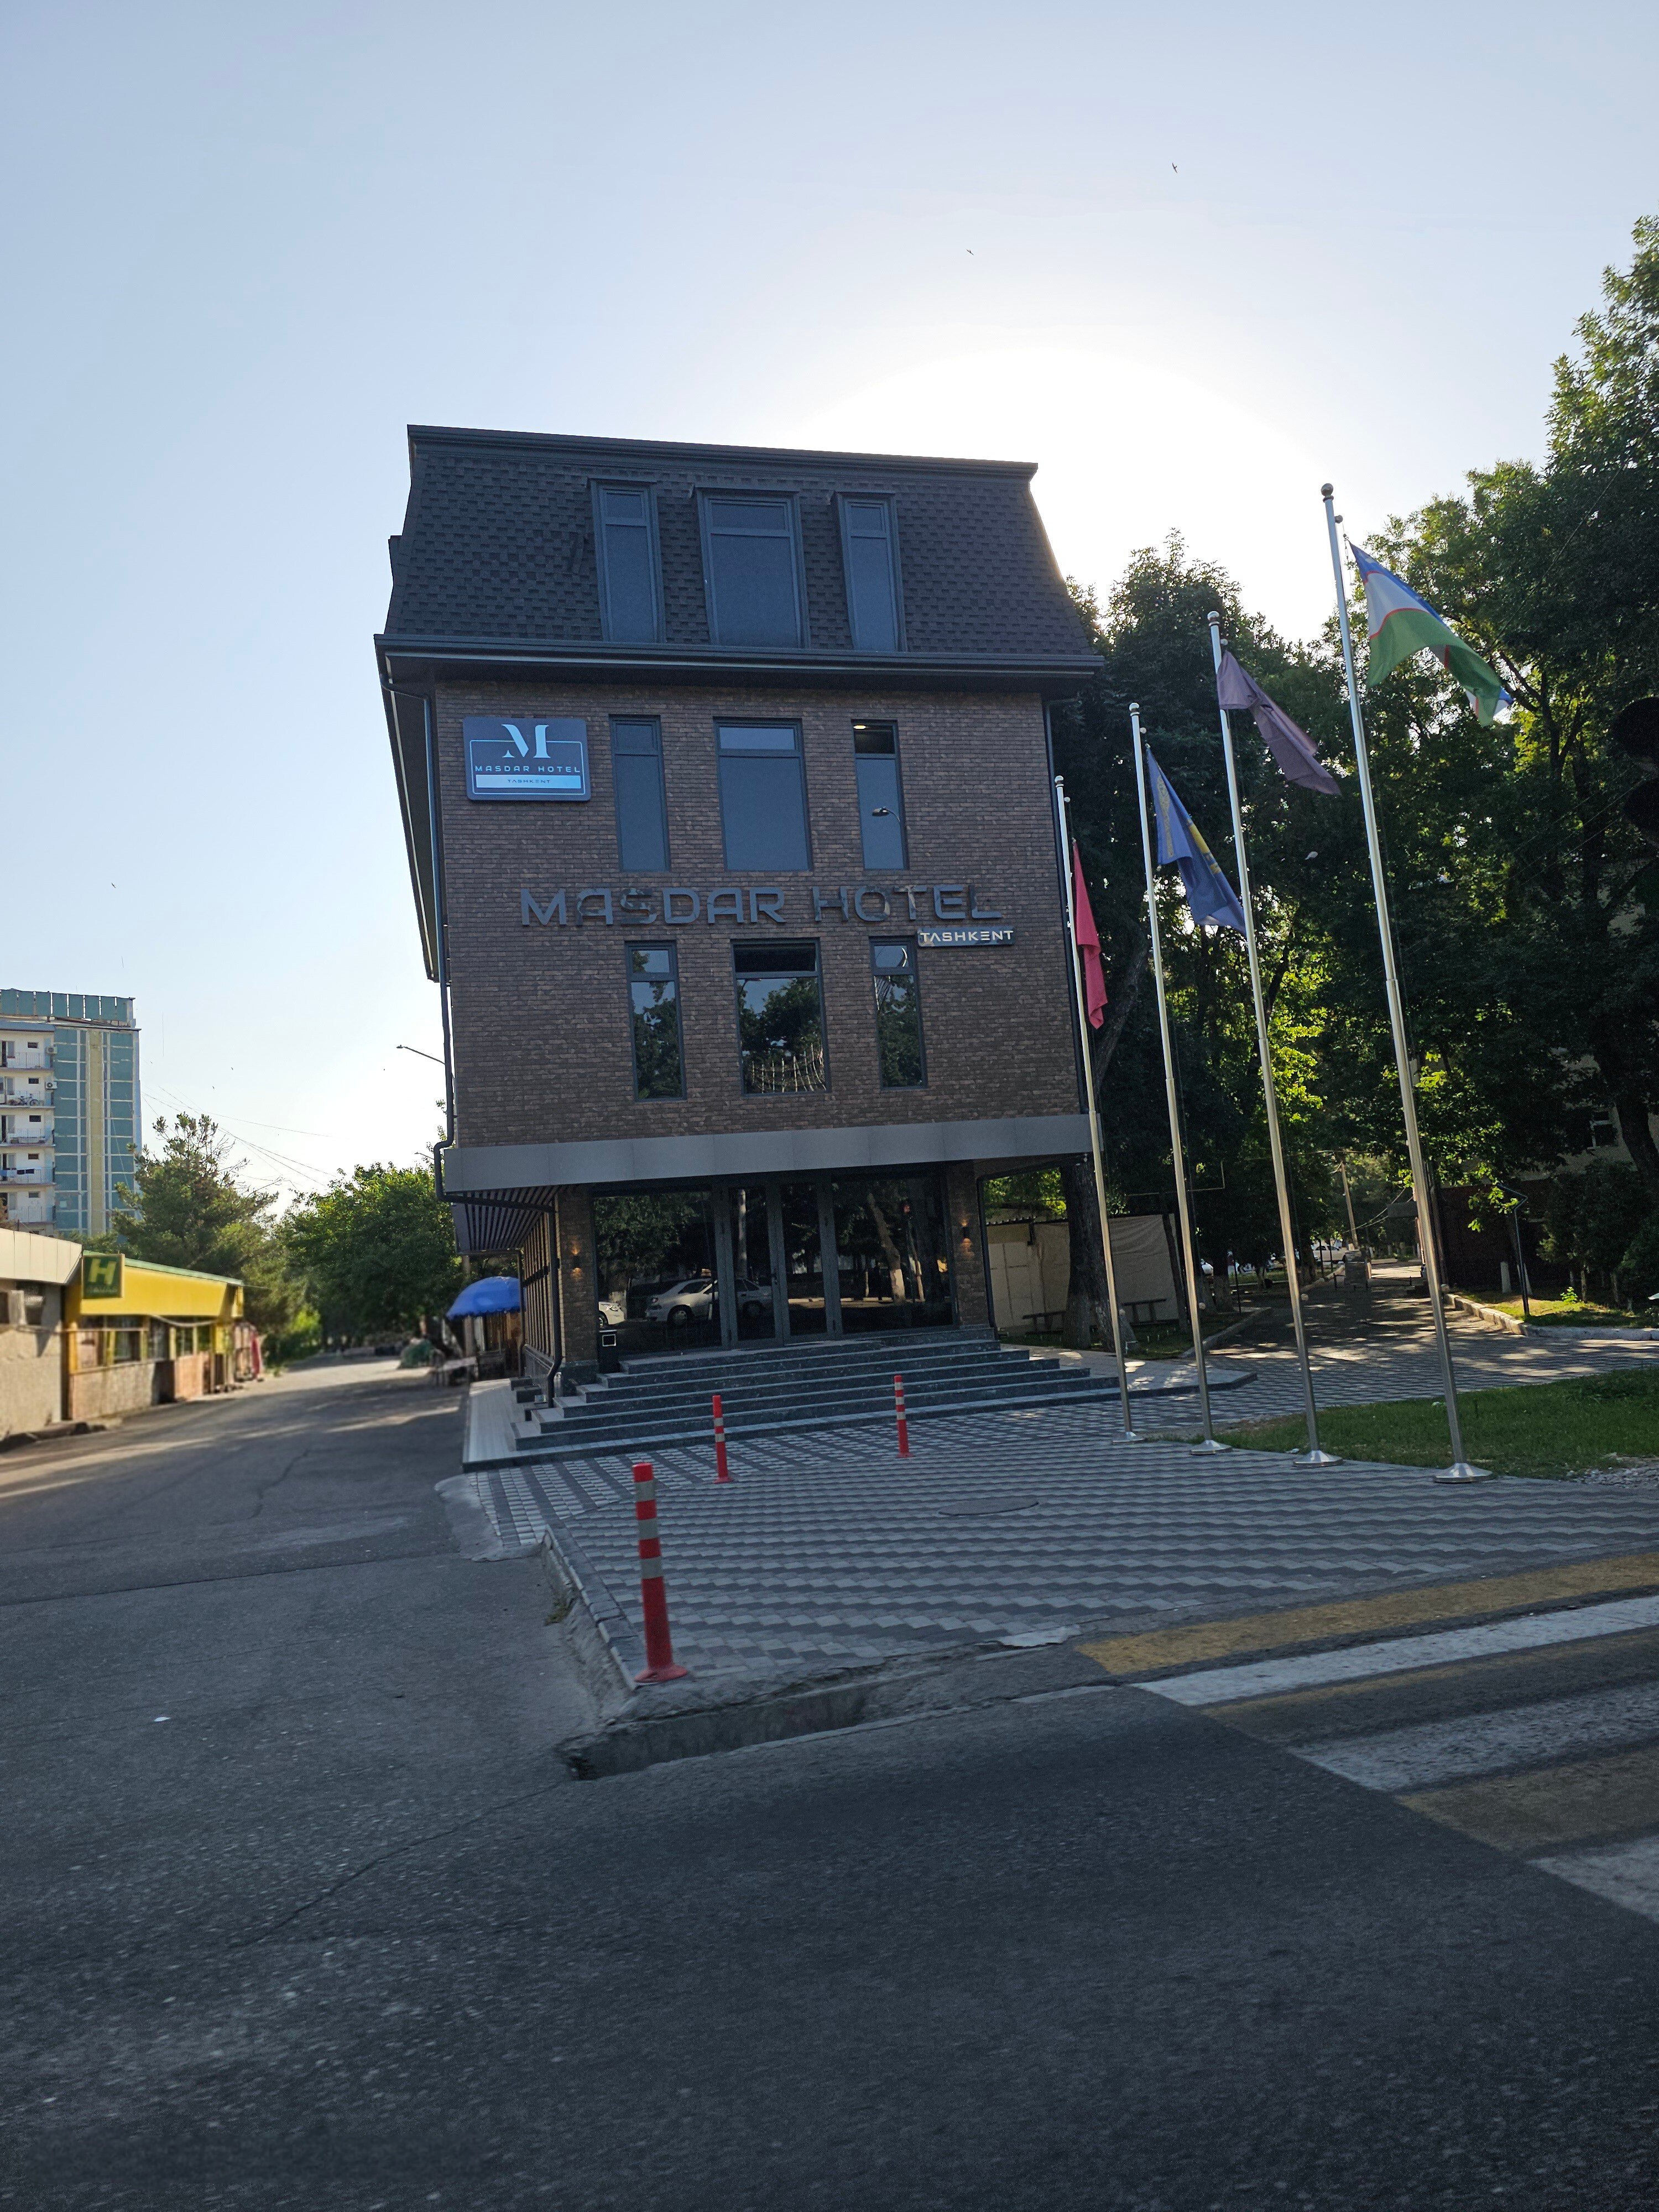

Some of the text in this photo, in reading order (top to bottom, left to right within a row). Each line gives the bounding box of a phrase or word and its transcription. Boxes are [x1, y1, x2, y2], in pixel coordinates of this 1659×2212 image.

[520, 885, 1002, 926] MASDAR HOTEL
[919, 930, 1014, 942] TASHKENT
[88, 1258, 117, 1285] H
